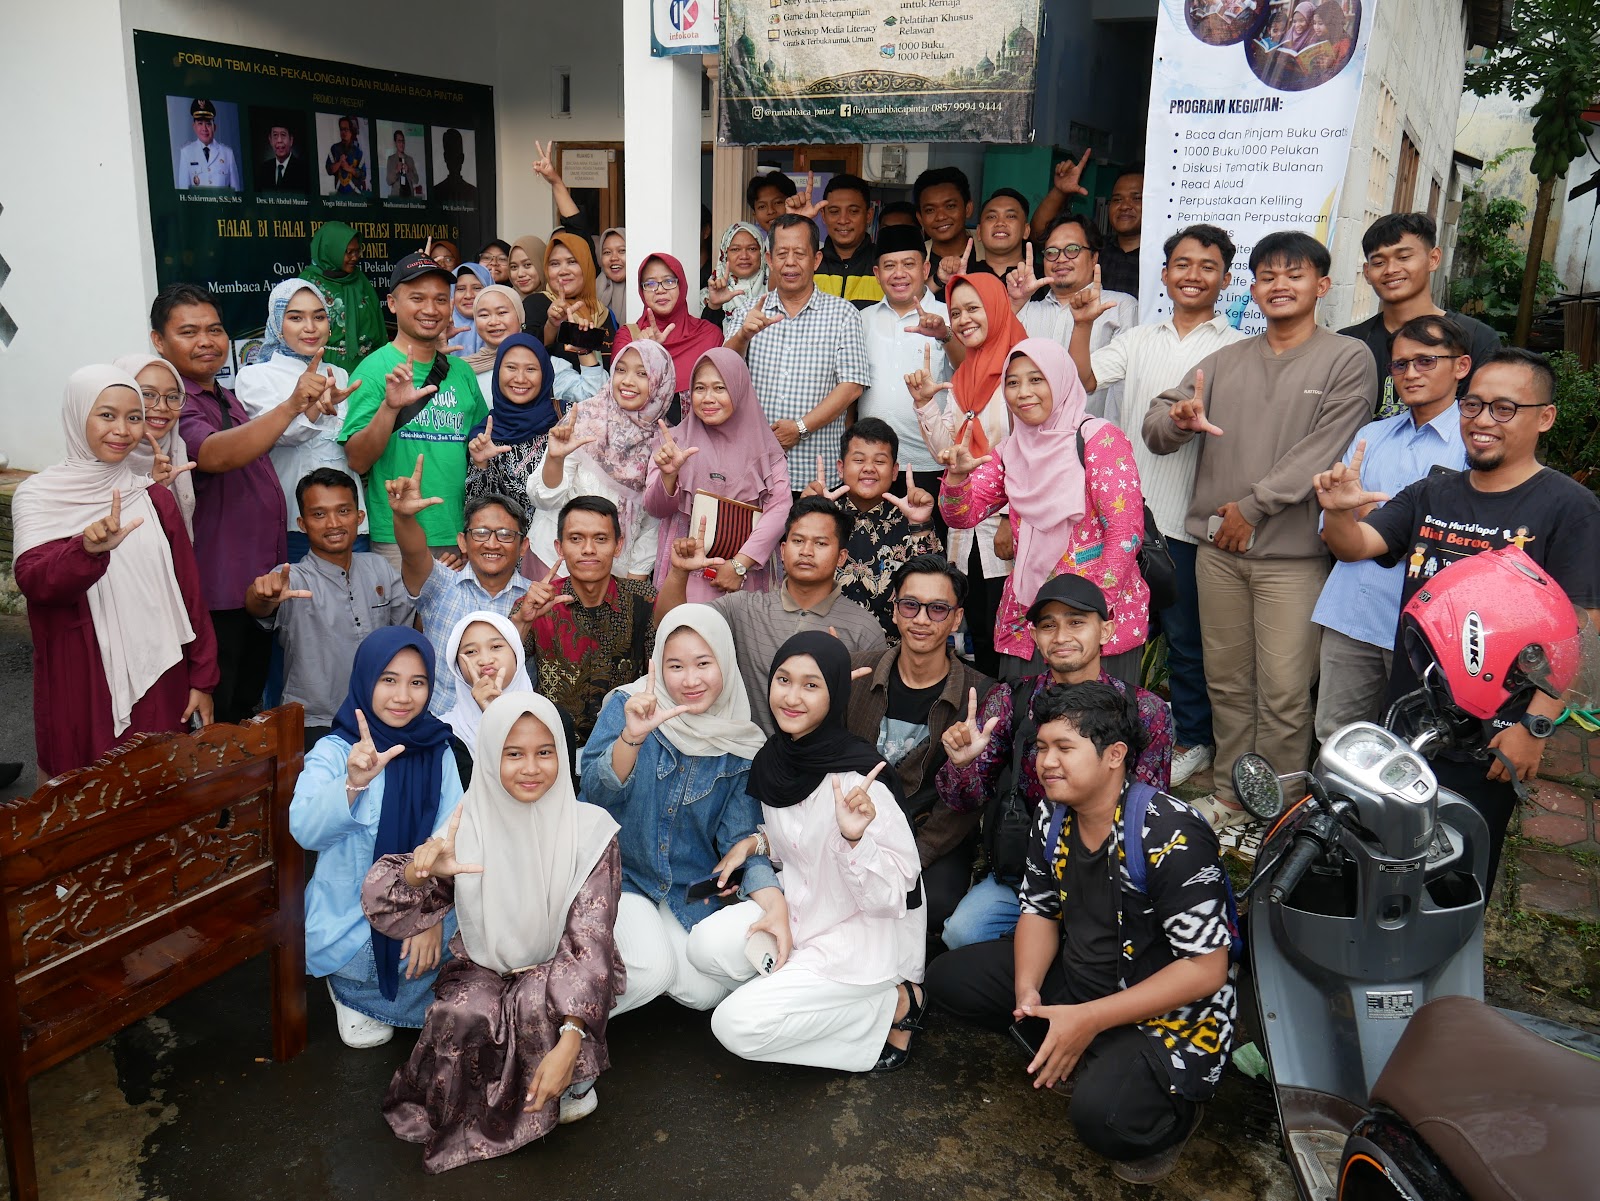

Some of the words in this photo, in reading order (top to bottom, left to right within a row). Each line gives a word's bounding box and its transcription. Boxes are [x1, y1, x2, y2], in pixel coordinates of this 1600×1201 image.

[900, 0, 926, 9] untuk
[783, 13, 803, 21] Game
[804, 11, 819, 19] dan
[820, 9, 871, 19] keterampilan
[899, 15, 938, 24] Pelatihan
[940, 13, 974, 22] Khusus
[669, 32, 699, 40] infokota
[783, 27, 819, 37] Workshop
[821, 25, 845, 34] Media
[846, 24, 877, 34] Literacy
[899, 27, 935, 35] Relawan
[832, 36, 851, 44] untuk
[898, 42, 920, 50] 1000
[921, 41, 945, 49] Buku
[920, 51, 955, 60] Pelukan
[178, 52, 223, 69] FORUM
[224, 58, 252, 73] TBM
[253, 63, 279, 77] KAB.
[280, 67, 350, 87] PEKALONGAN
[351, 78, 372, 90] DAN
[373, 81, 407, 95] RUMAH
[408, 86, 433, 98] BACA
[434, 90, 465, 104] PINTAR
[853, 105, 930, 116] fb/rumahbacapintar
[931, 103, 953, 113] 0857
[953, 102, 976, 112] 9994
[978, 102, 1002, 112] 9444
[1169, 99, 1225, 115] PROGRAM
[1228, 97, 1284, 114] KEGIATAN:
[764, 108, 836, 118] @rumahbaca_pintar
[1185, 130, 1216, 140] Baca
[1218, 129, 1242, 140] dan
[1244, 128, 1284, 141] Pinjam
[1287, 128, 1317, 138] Buku
[1184, 147, 1210, 156] 1000
[1212, 147, 1240, 157] Buku
[1241, 145, 1267, 155] 1000
[1271, 145, 1319, 155] Pelukan
[1183, 163, 1222, 173] Diskusi
[1225, 162, 1269, 173] Tematik
[1272, 162, 1323, 172] Bulanan
[1181, 180, 1210, 189] Read
[1213, 179, 1244, 189] Aloud
[1179, 196, 1256, 207] Perpustakaan
[1260, 196, 1303, 208] Keliling
[1177, 212, 1241, 222] Pembinaan
[1244, 212, 1328, 224] Perpustakaan
[217, 219, 252, 237] HALAL
[258, 220, 268, 237] BI
[273, 220, 306, 237] HALAL
[394, 224, 448, 239] PEKALONGAN
[361, 243, 388, 258] PANEL
[273, 262, 296, 275] Quo
[365, 261, 398, 273] Pekalo
[208, 281, 260, 294] Membaca
[1469, 619, 1480, 668] INK
